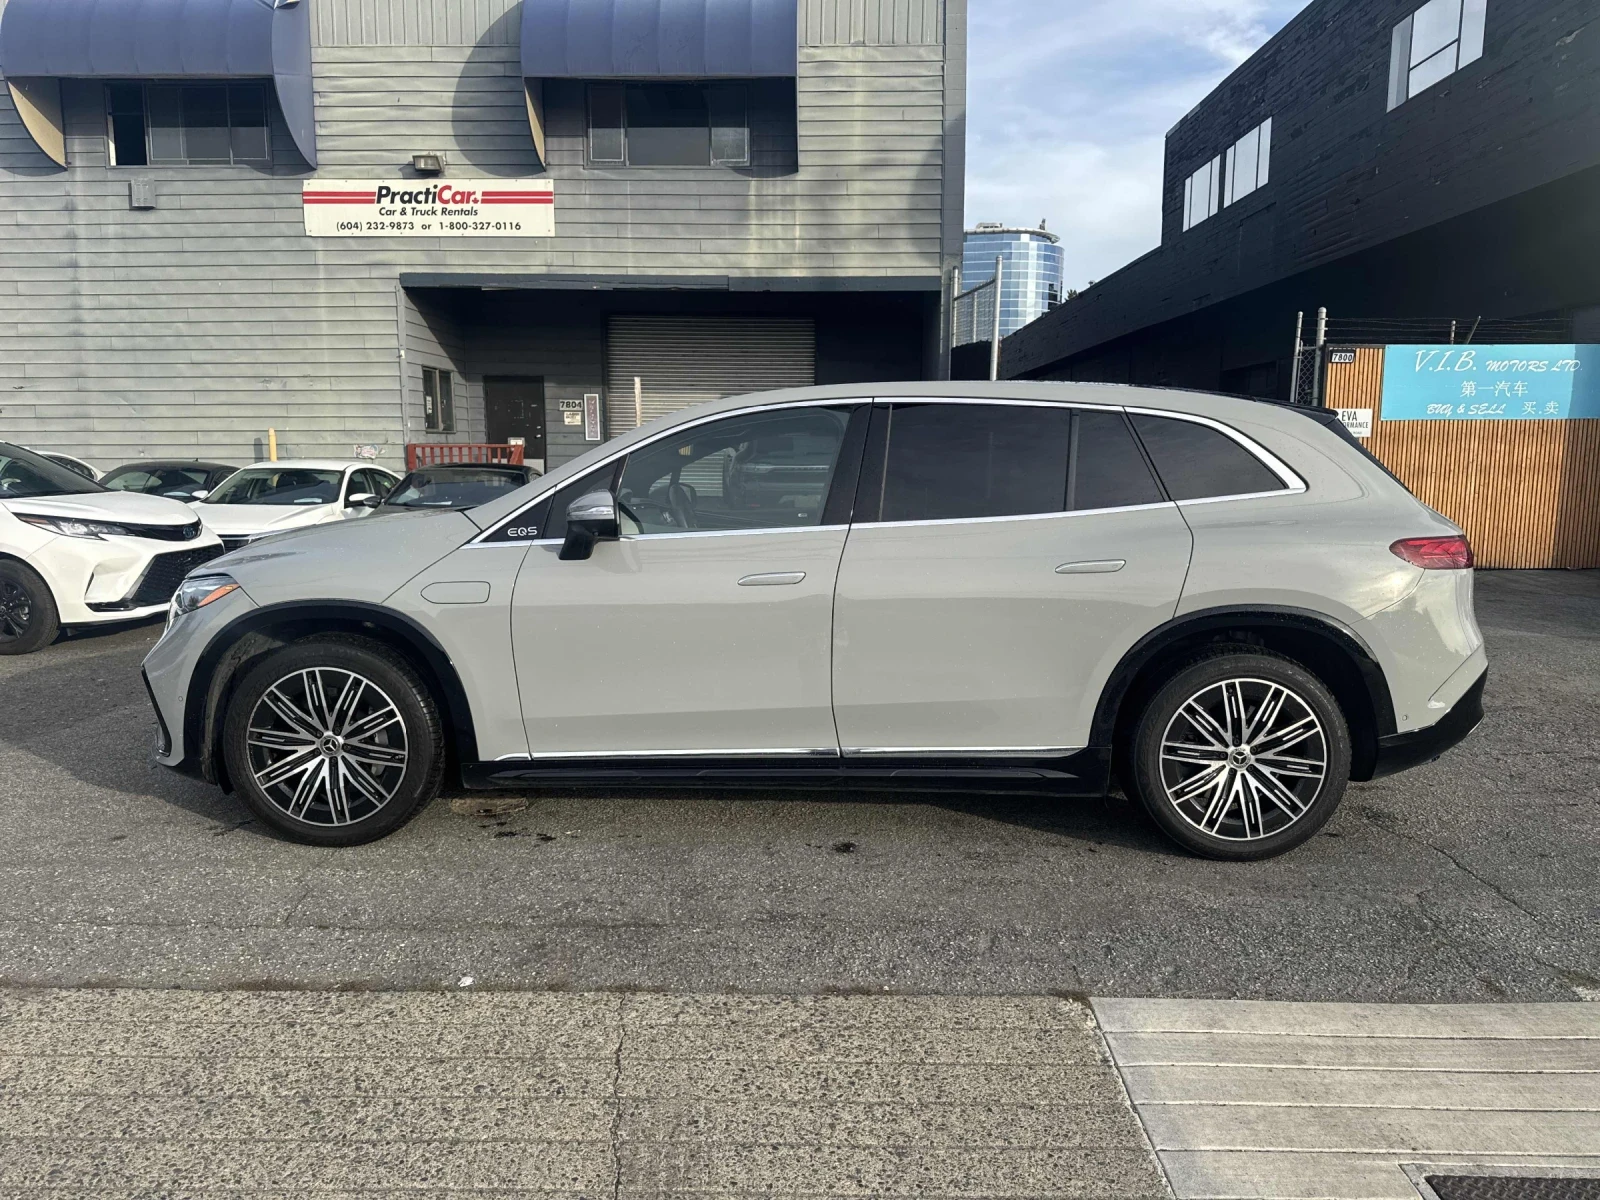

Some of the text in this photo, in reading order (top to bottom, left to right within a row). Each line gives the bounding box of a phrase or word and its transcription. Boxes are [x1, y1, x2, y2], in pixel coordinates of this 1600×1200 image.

[376, 184, 476, 205] PractiCar
[379, 206, 478, 216] Car & Truck Rentals
[336, 222, 363, 232] (604)
[366, 222, 415, 230] 232-9873
[439, 222, 521, 231] 1-800-327-0116
[1333, 353, 1353, 361] 7800
[1415, 350, 1477, 373] V.I.B.
[1485, 360, 1549, 372] MOTORS
[1460, 380, 1529, 398] 第一汽车
[1426, 403, 1453, 417] BUY
[1456, 403, 1466, 414] &
[1467, 402, 1507, 415] SELL
[1341, 410, 1358, 421] EVA
[507, 526, 538, 537] EQS
